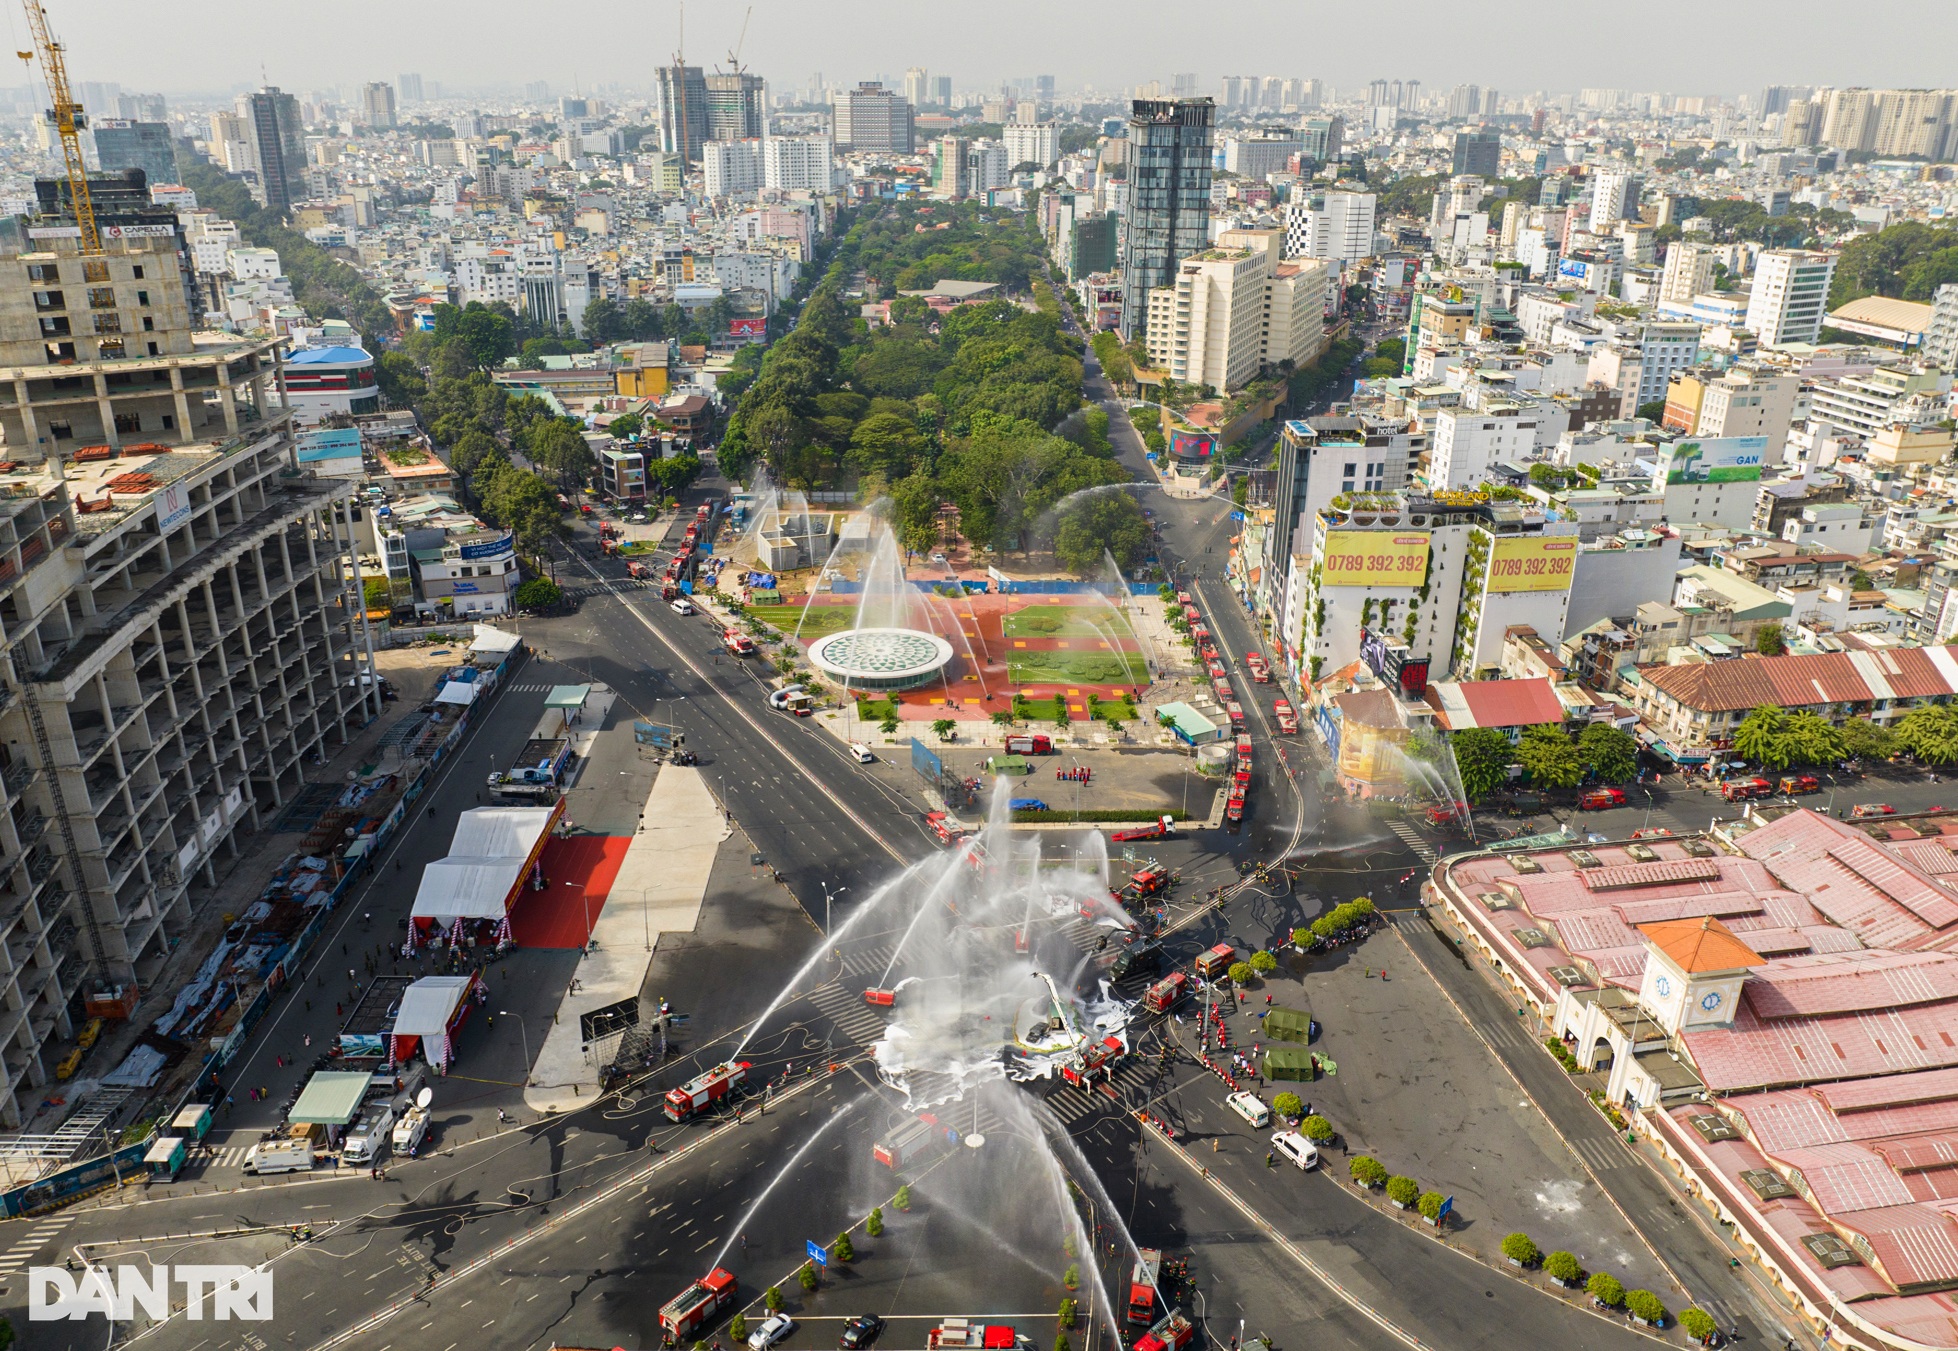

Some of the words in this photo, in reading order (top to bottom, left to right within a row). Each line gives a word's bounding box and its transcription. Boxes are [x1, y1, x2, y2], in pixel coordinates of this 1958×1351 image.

[1377, 426, 1398, 434] hotel
[1736, 456, 1759, 465] GAN
[160, 505, 189, 528] NEWTECONS
[1327, 555, 1364, 571] 0789
[1367, 555, 1394, 571] 392
[1396, 555, 1424, 571] 392
[1492, 559, 1523, 576] 0789
[1524, 558, 1547, 575] 392
[1548, 557, 1571, 574] 392
